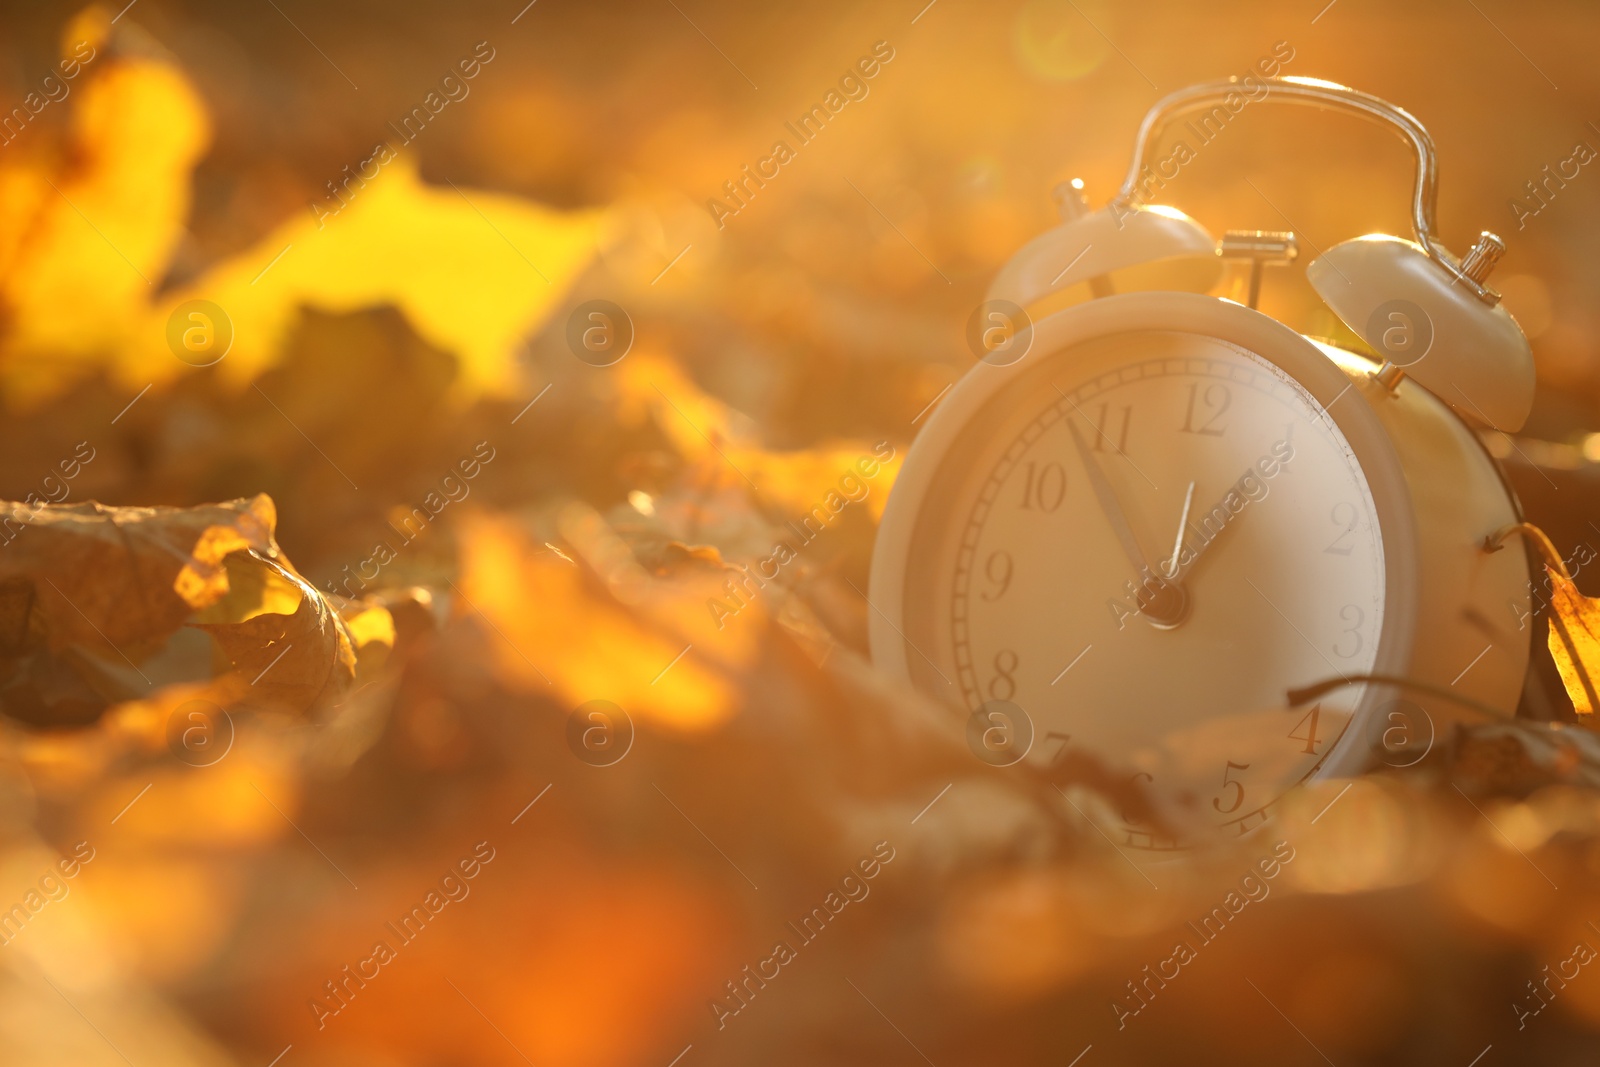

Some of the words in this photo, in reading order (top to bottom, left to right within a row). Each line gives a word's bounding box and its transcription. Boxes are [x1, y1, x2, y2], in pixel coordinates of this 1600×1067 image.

[1090, 402, 1132, 456] 11
[1178, 381, 1232, 437] 12
[1020, 460, 1067, 514] 10
[1322, 502, 1360, 557] 2
[978, 551, 1014, 603] 9
[1332, 604, 1365, 659] 3
[988, 649, 1019, 702] 8
[1287, 702, 1321, 756] 4
[1213, 760, 1250, 814] 5
